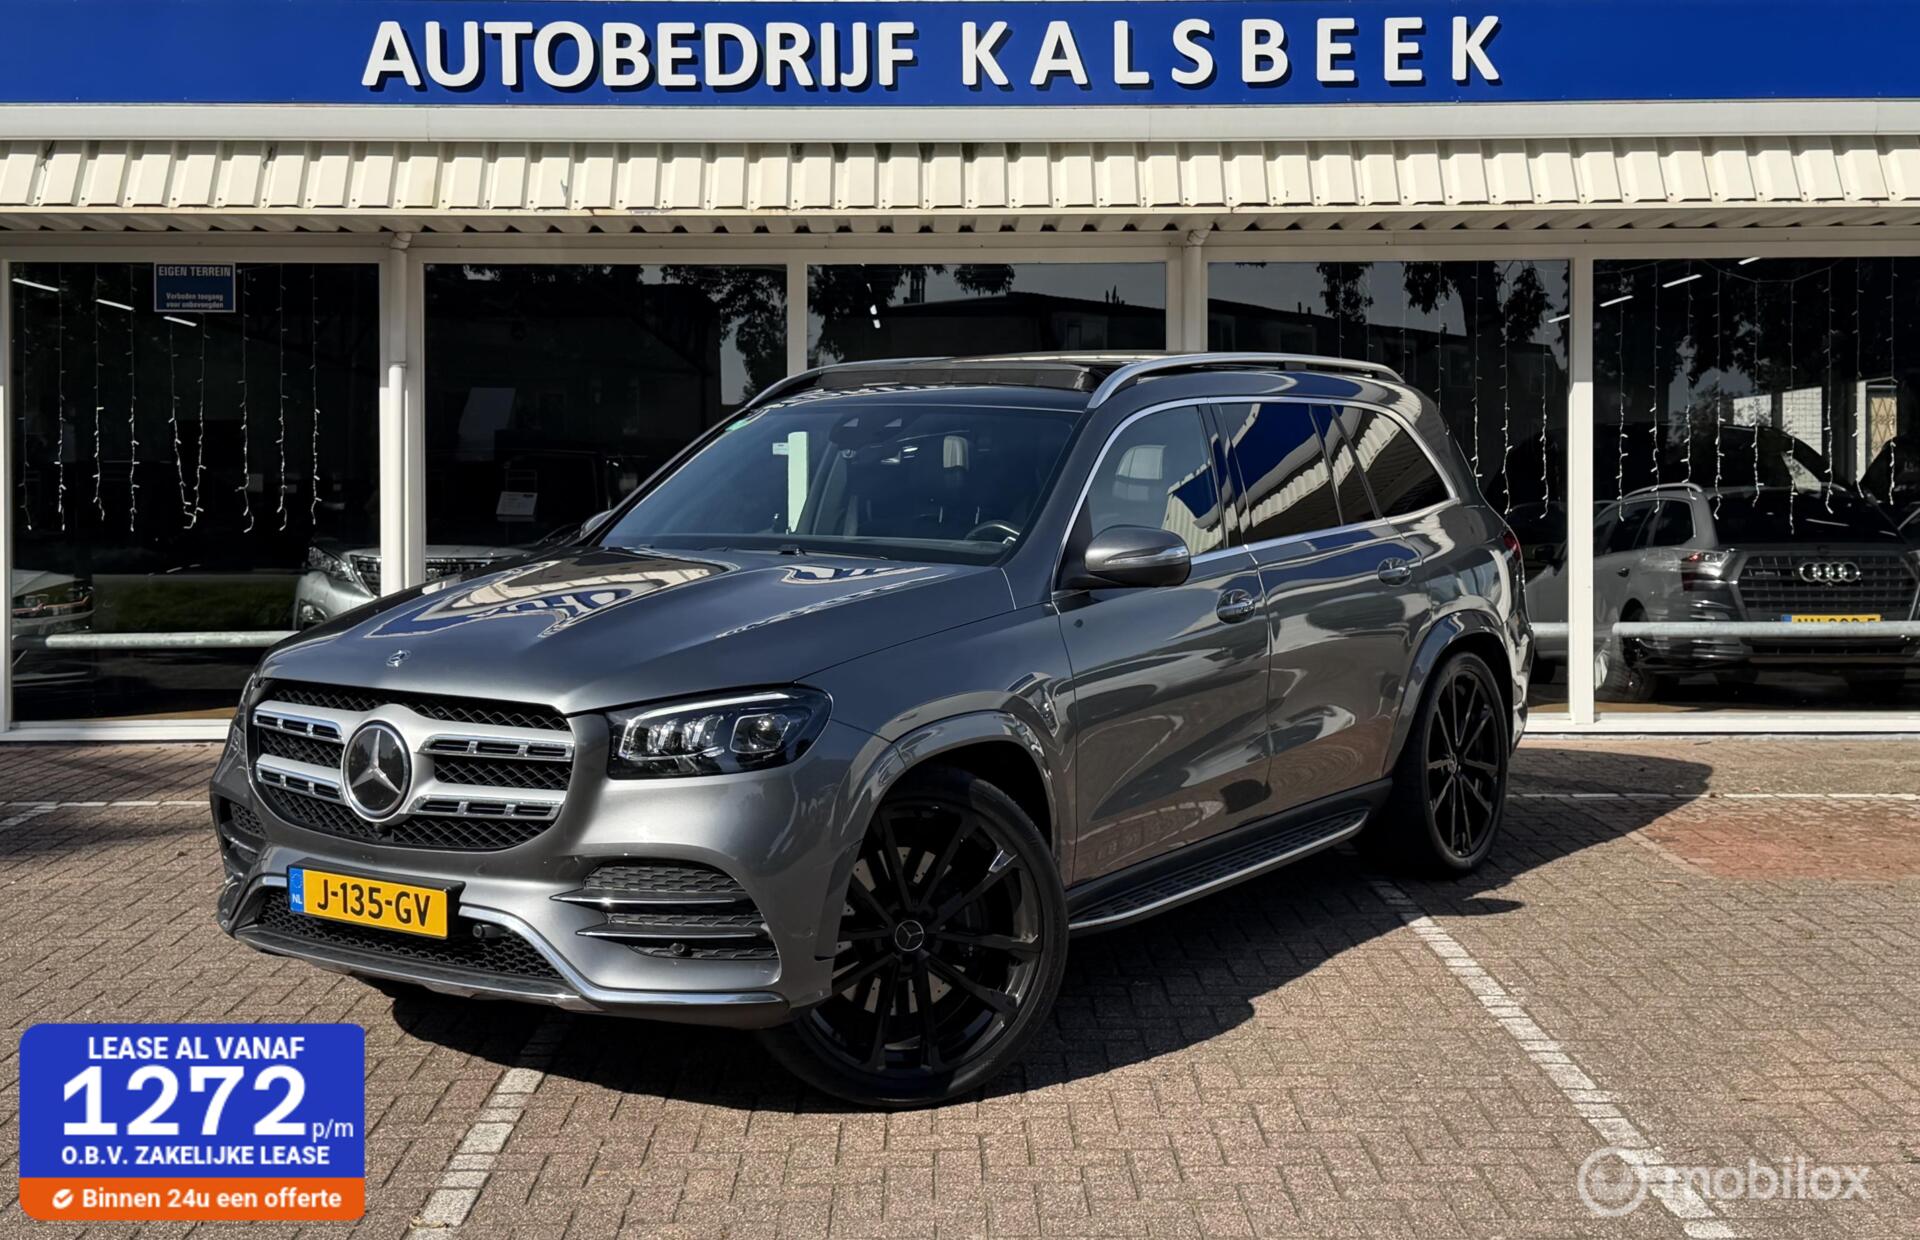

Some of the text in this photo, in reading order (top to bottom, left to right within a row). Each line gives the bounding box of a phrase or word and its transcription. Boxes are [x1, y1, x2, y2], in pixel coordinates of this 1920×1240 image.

[362, 16, 1499, 87] AUTOBEDRIJF KALSBEEK
[158, 266, 231, 277] EIGEN TERREIN
[166, 292, 224, 302] Verboden toegang
[292, 893, 303, 905] NL
[316, 879, 431, 927] J-135-GV
